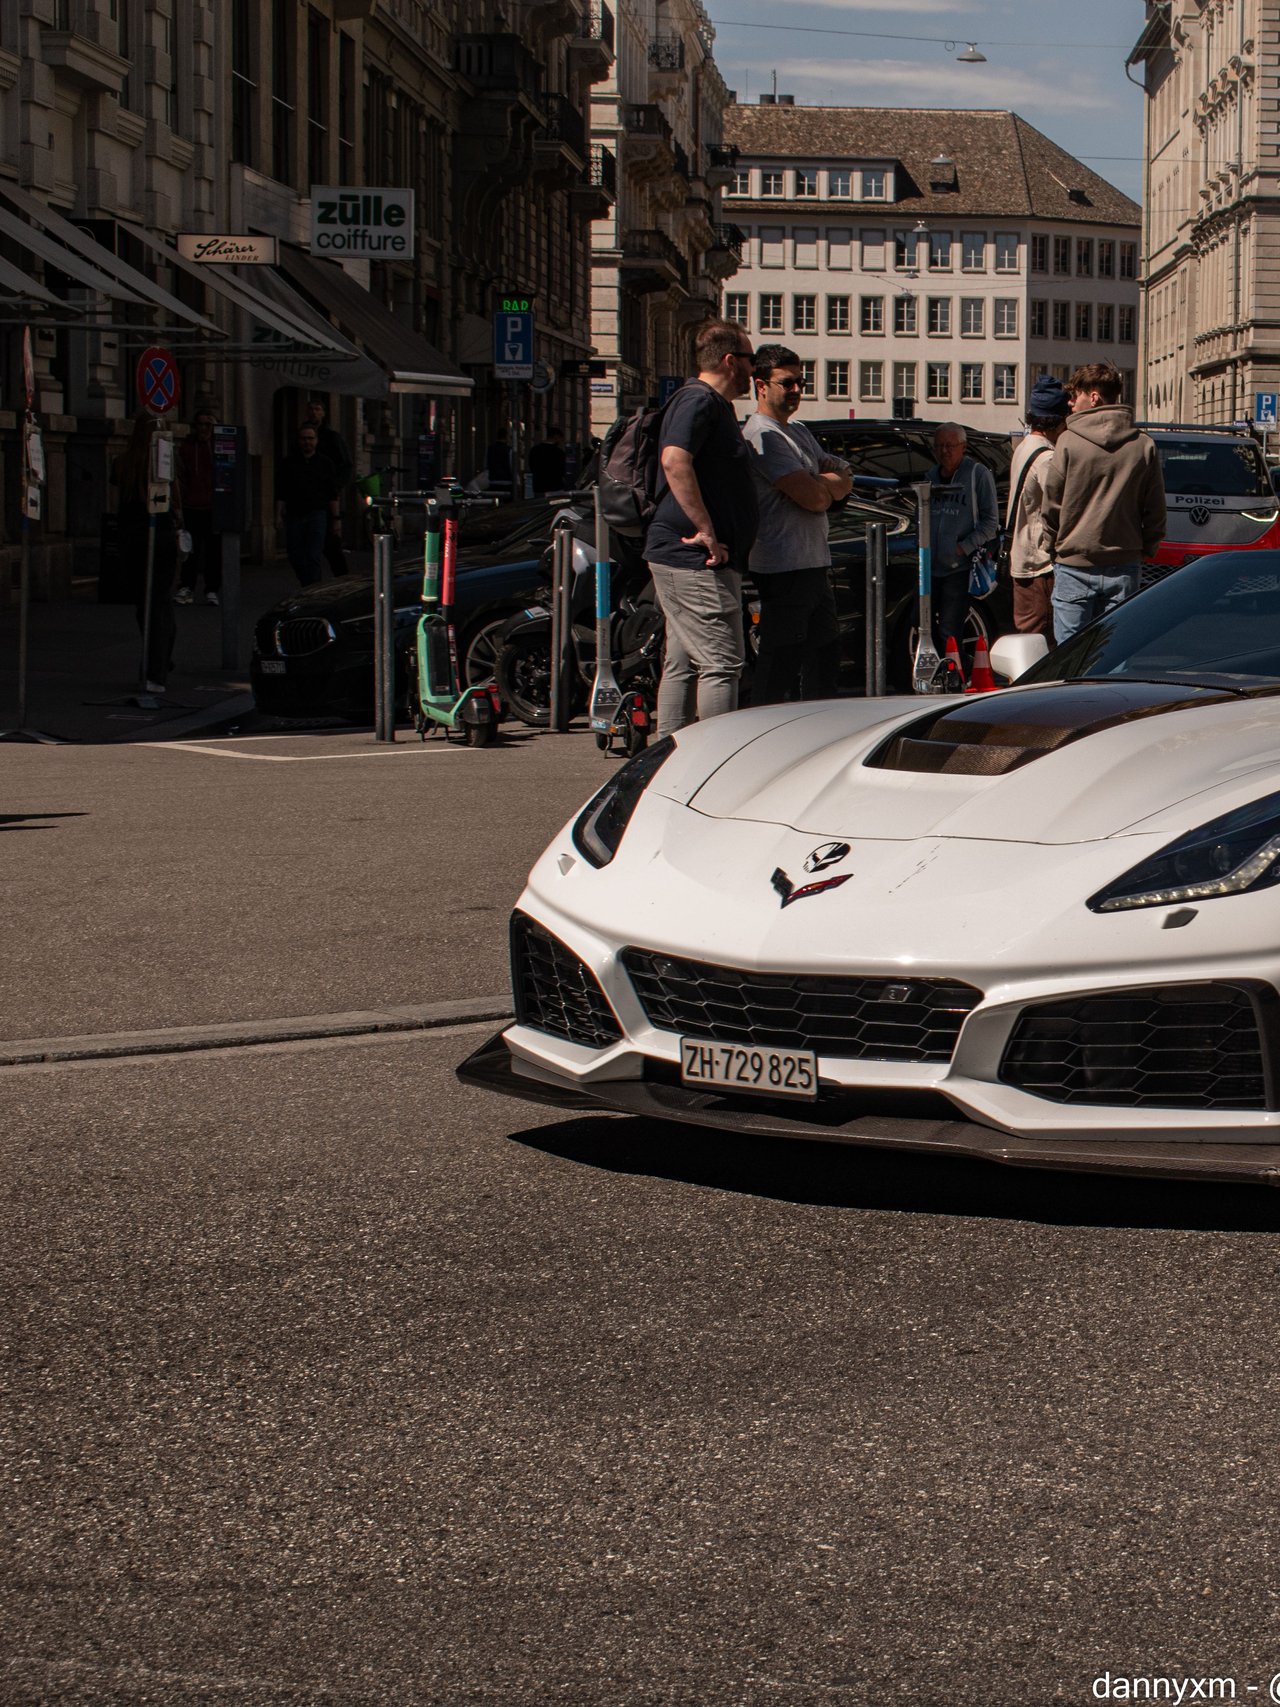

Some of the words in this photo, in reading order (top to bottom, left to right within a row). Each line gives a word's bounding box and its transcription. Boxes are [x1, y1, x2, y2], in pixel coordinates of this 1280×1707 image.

[316, 228, 406, 251] coiffure
[506, 316, 523, 341] P
[666, 380, 675, 394] P
[1262, 395, 1272, 409] P
[1175, 496, 1226, 505] Polizei
